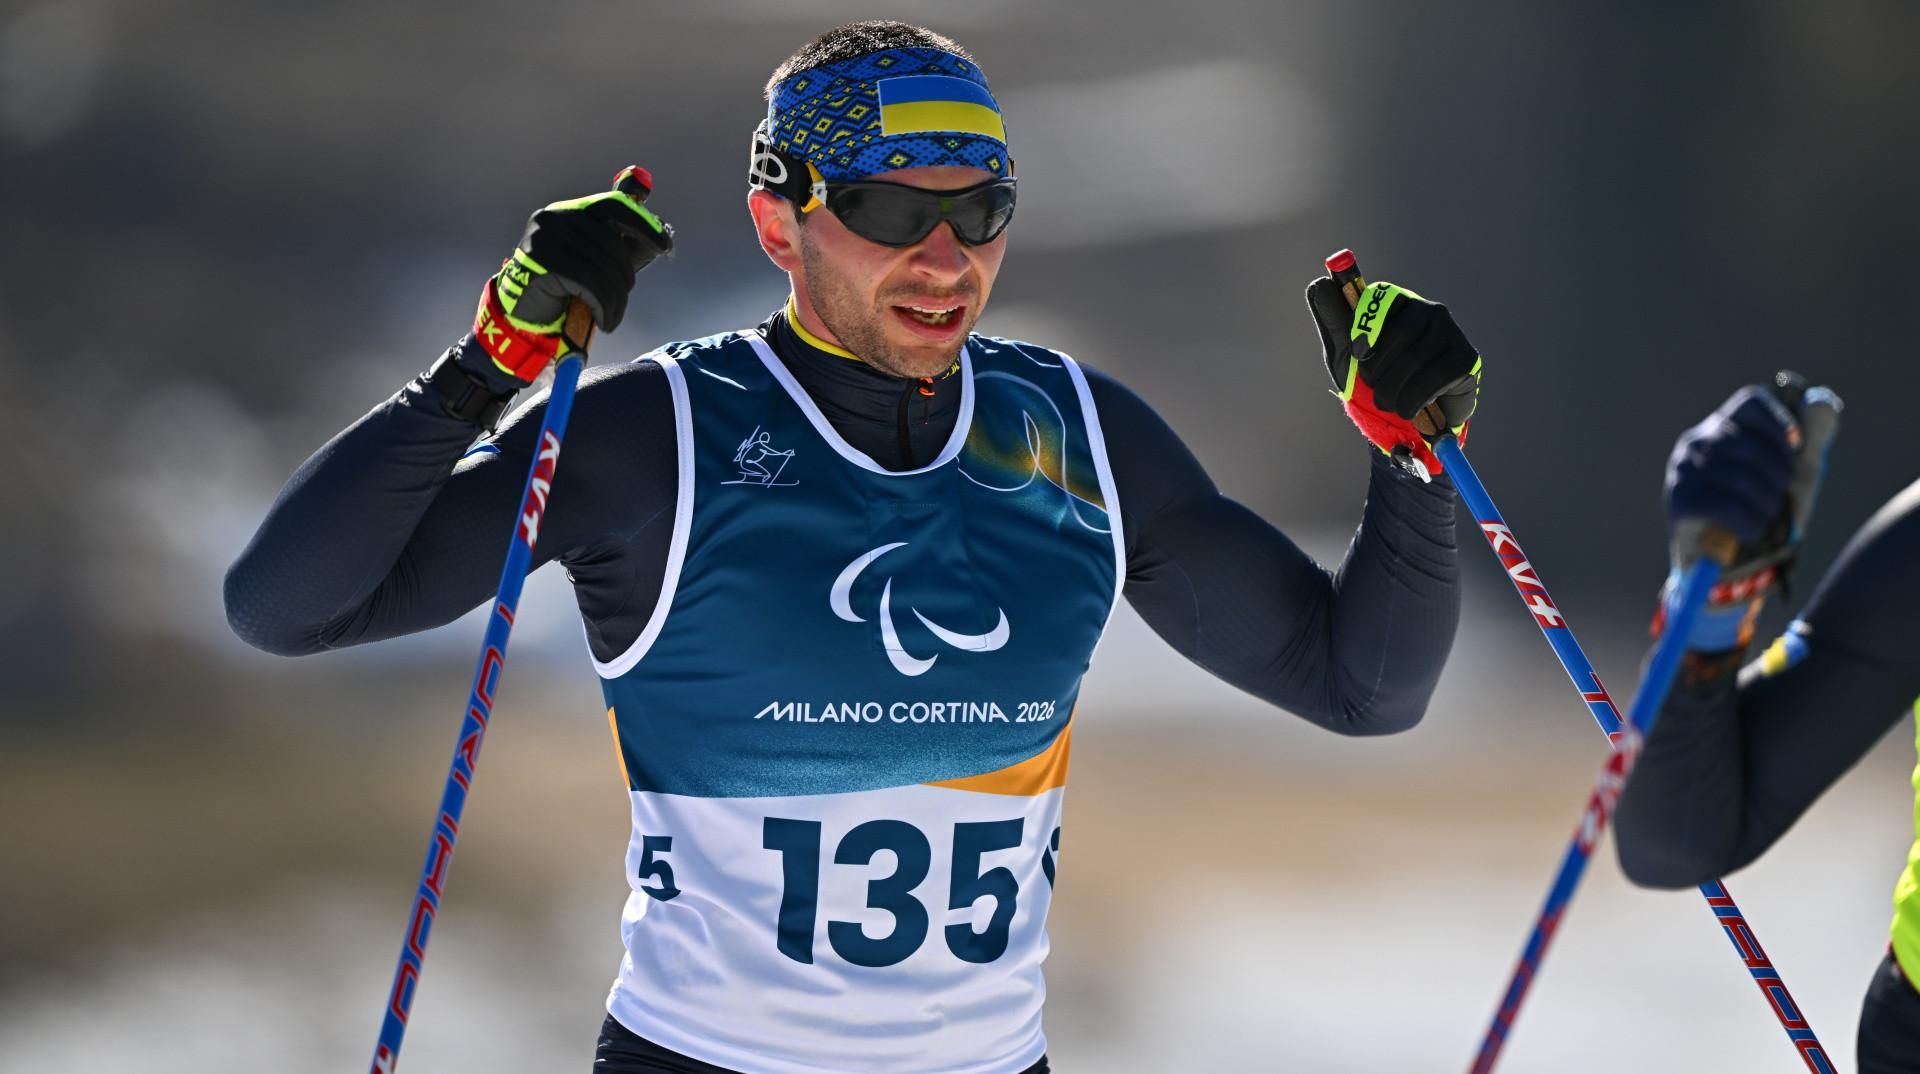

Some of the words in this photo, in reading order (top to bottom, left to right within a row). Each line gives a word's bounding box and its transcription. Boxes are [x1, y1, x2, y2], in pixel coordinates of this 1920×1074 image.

[1479, 523, 1562, 626] KV+
[754, 701, 883, 723] MILANO
[889, 701, 1010, 723] CORTINA
[1015, 700, 1056, 723] 2026
[762, 816, 1025, 967] 135
